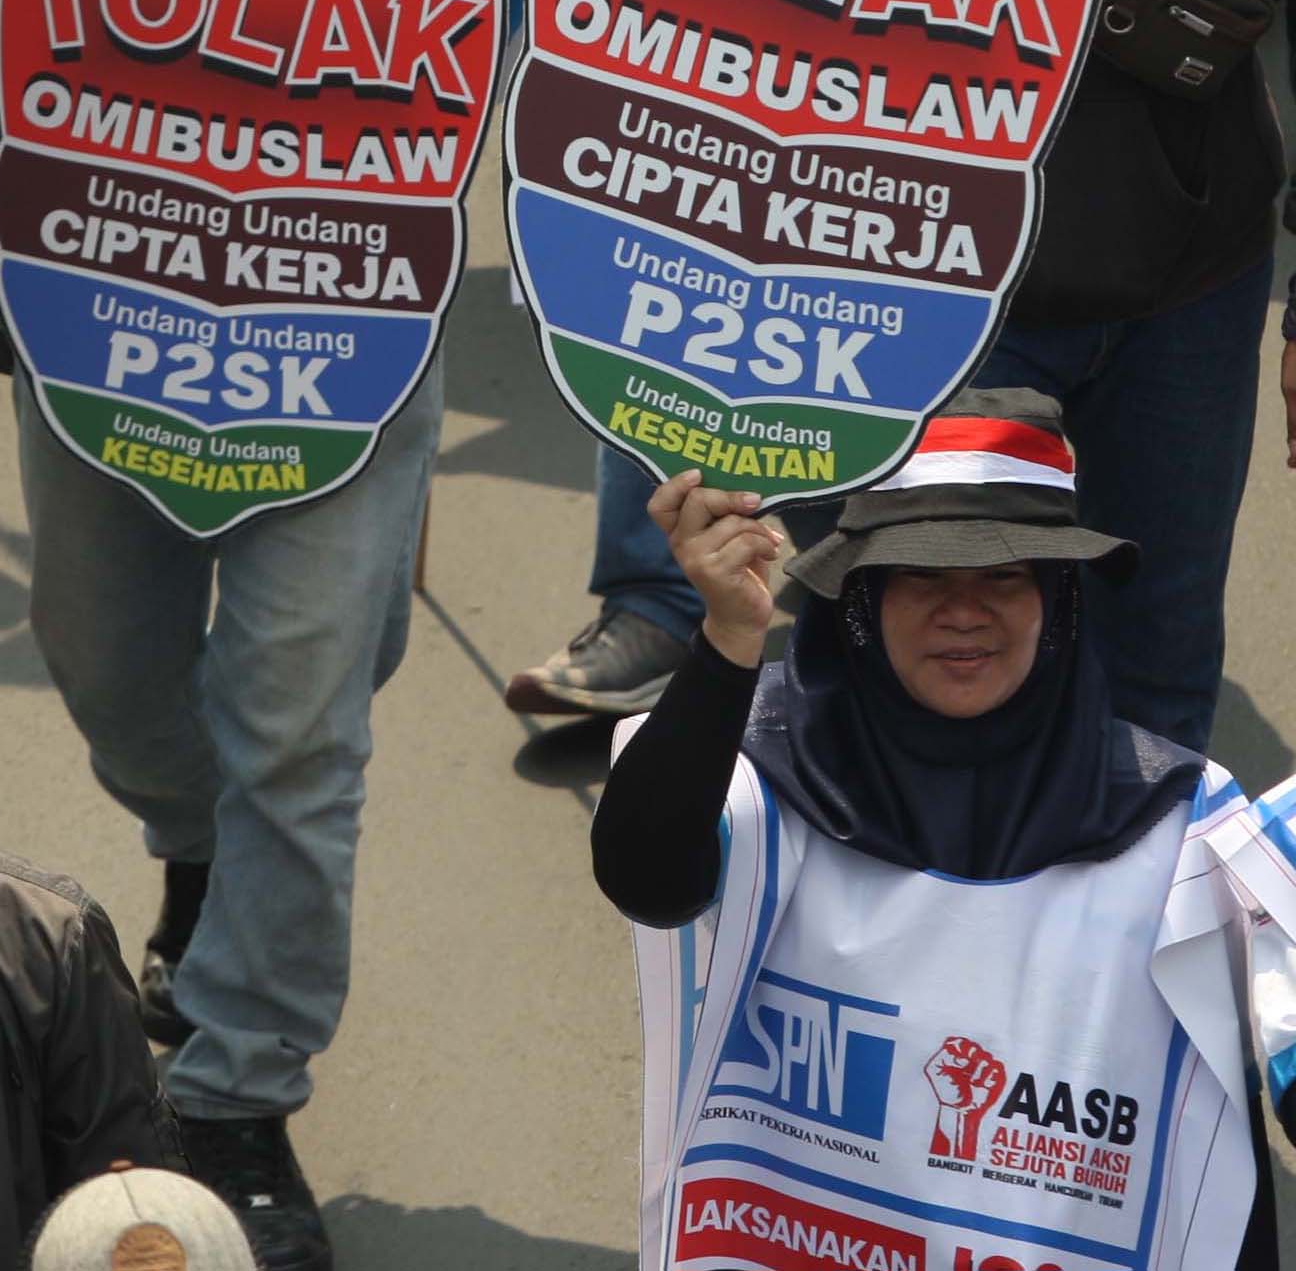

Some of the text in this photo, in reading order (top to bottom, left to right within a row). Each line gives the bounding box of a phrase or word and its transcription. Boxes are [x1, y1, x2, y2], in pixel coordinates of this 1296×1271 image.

[21, 79, 457, 183] OMIBUSLAW
[618, 102, 951, 218] Undang Undang
[87, 175, 389, 253] Undang Undang
[563, 137, 983, 277] CIPTA KERJA
[40, 208, 422, 302] CIPTA KERJA
[613, 236, 905, 334] Undang Undang
[92, 294, 356, 359] Undang Undang
[619, 280, 873, 400] P2SK
[104, 330, 333, 416] P2SK
[113, 412, 301, 465] Undang Undang
[608, 402, 836, 482] KESEHATAN
[624, 376, 832, 452] Undang Undang
[102, 434, 306, 493] KESEHATAN
[715, 981, 852, 1118] SPN
[758, 1113, 813, 1145] PEKERJA
[813, 1133, 881, 1165] NASIONAL
[998, 1072, 1139, 1147] AASB
[990, 1149, 1128, 1195] SEJUTA BURUH
[991, 1126, 1132, 1176] ALIANSI AKSI
[685, 1198, 918, 1271] LAKSANAKAN
